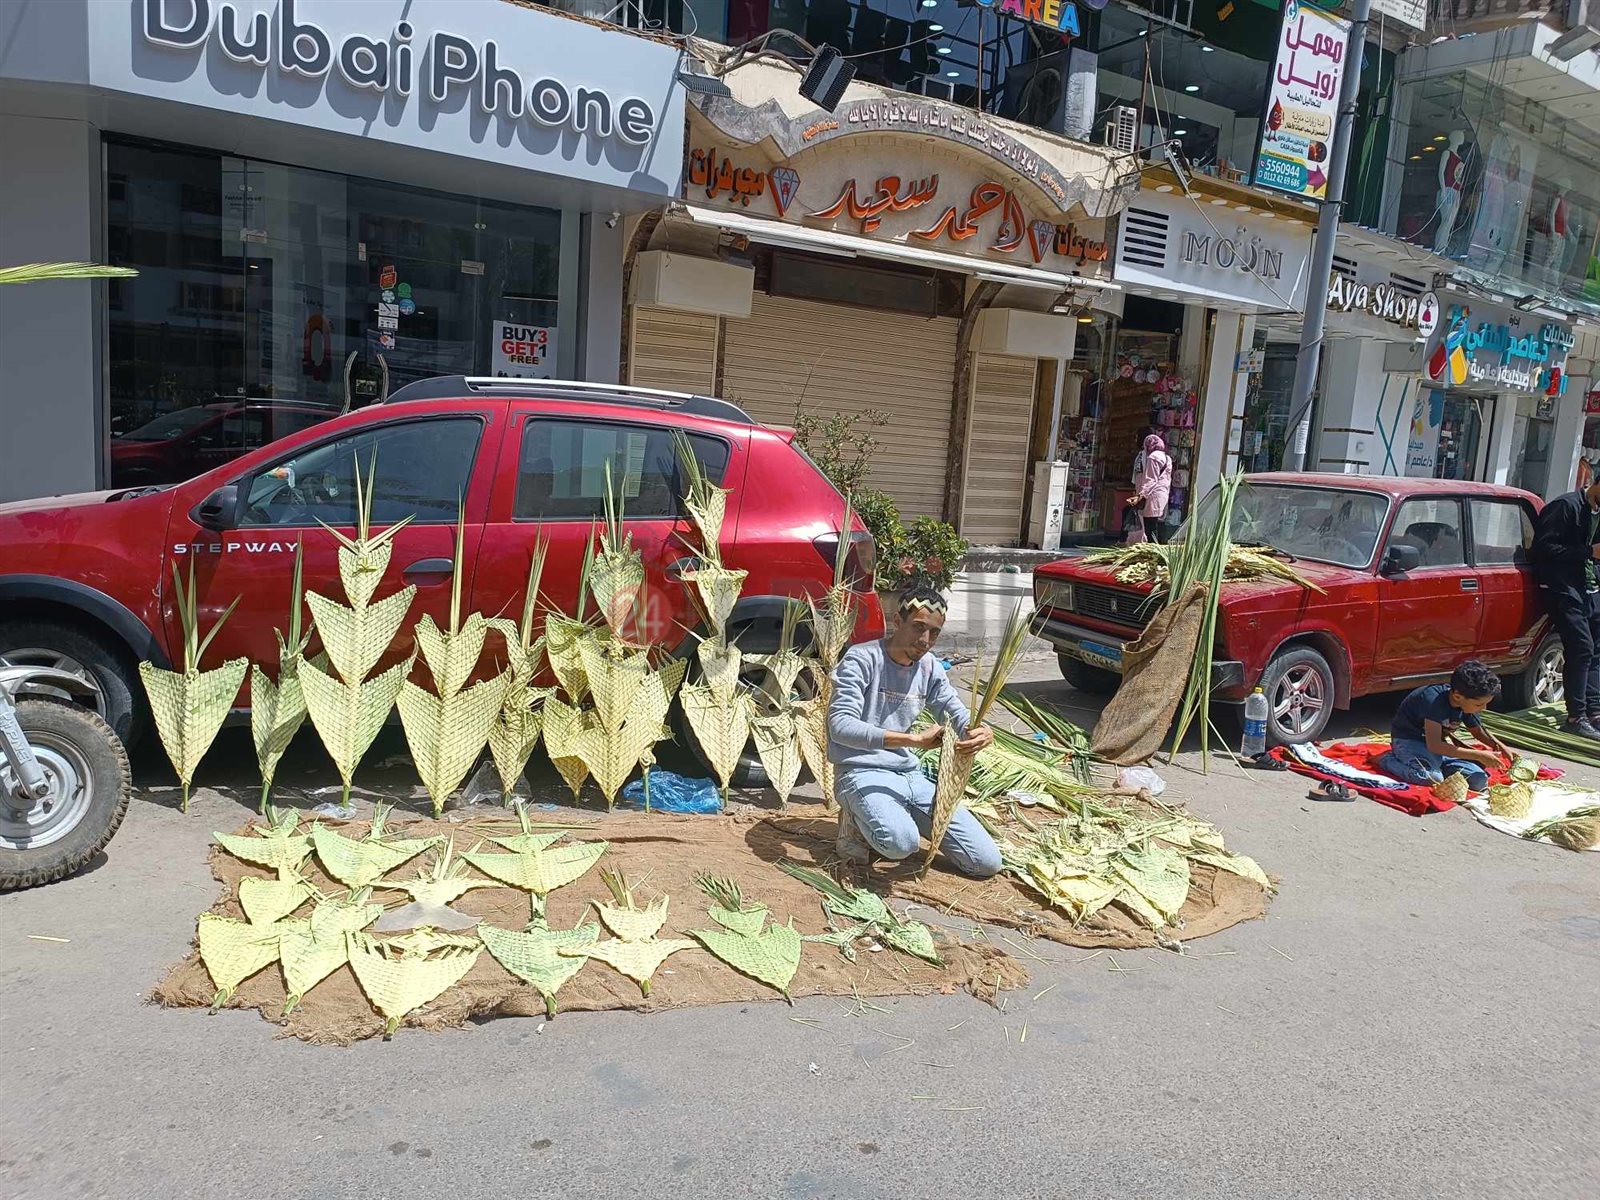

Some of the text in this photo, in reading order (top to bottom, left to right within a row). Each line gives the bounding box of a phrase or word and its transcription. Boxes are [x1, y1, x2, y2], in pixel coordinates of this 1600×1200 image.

[1000, 0, 1080, 36] AREA
[1285, 15, 1343, 64] معمل
[144, 0, 656, 147] Dubai Phone
[1277, 51, 1338, 100] زويل
[689, 148, 765, 206] مجوهرات
[1266, 159, 1300, 178] 5560944
[804, 174, 939, 234] سعيد
[1328, 272, 1417, 327] Aya Shop
[510, 354, 539, 365] FREE
[1543, 324, 1575, 351] صيدليات
[174, 542, 299, 554] STEPWAY
